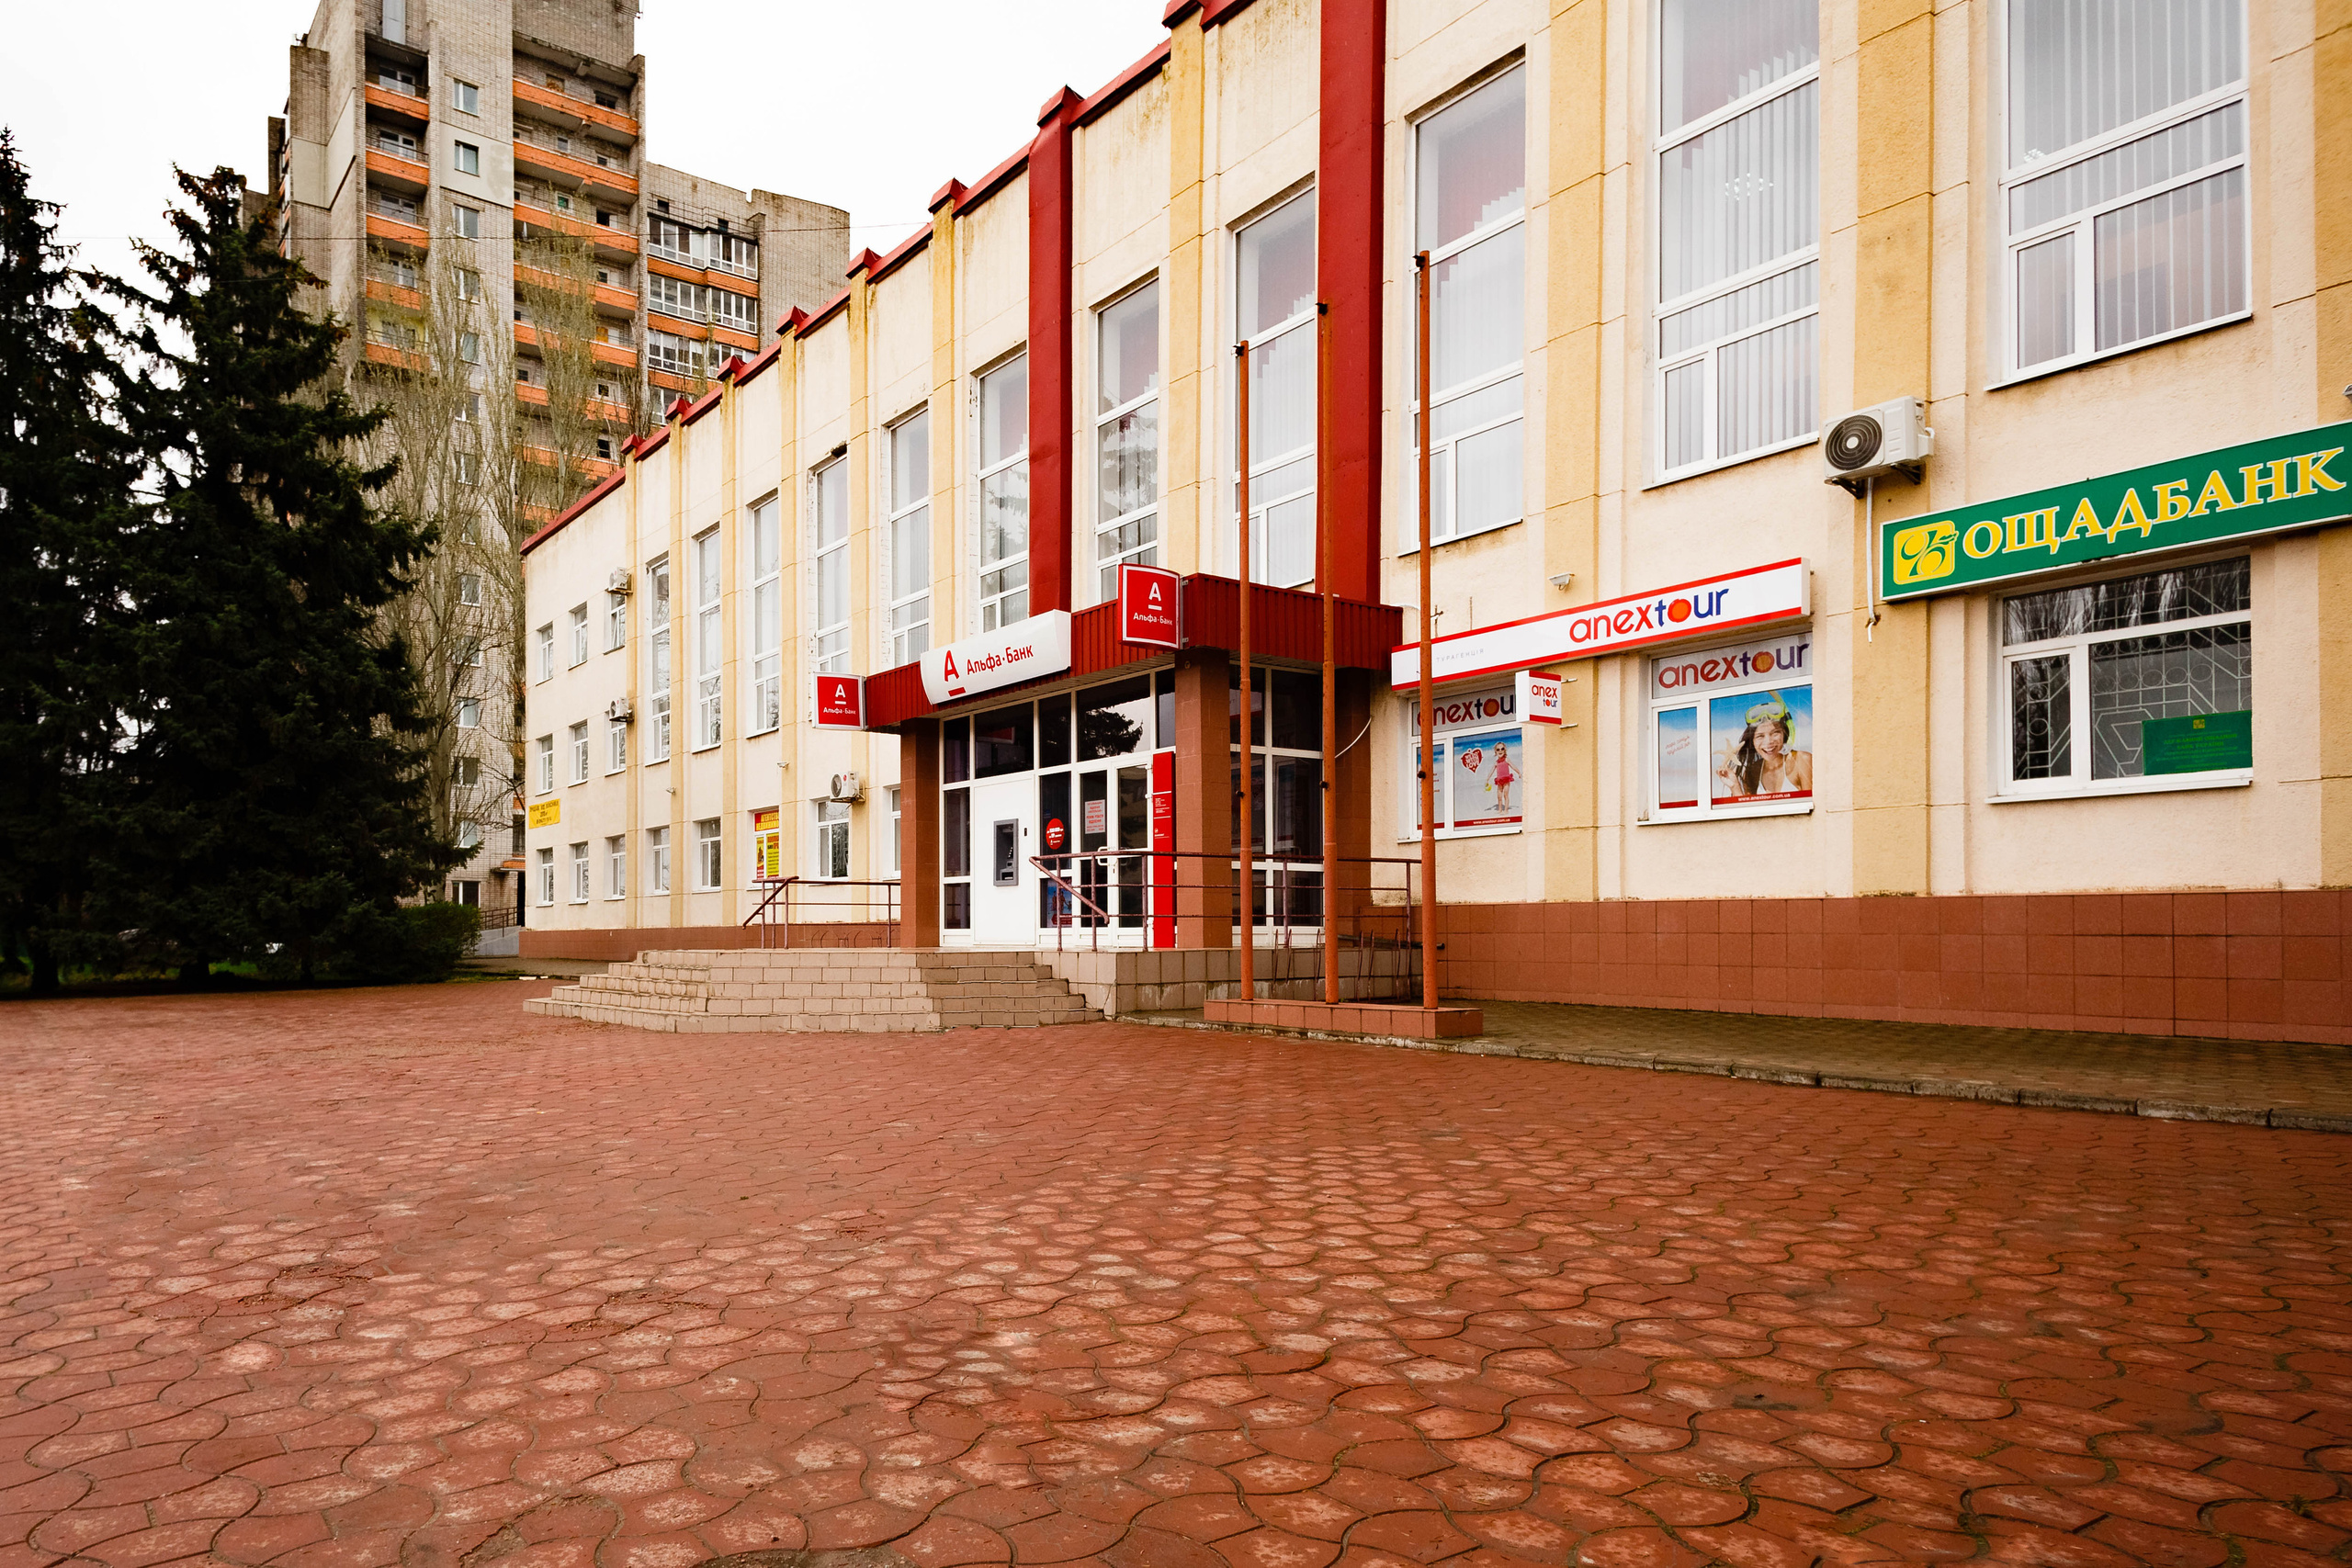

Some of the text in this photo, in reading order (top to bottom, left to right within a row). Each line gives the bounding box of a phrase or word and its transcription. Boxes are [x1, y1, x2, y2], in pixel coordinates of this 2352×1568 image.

[1962, 446, 2346, 559] ОЩАДБАНК
[1569, 588, 1729, 643] anextour
[1658, 643, 1810, 689] anextour
[1417, 694, 1516, 727] nextou
[1532, 684, 1558, 699] anex
[1543, 698, 1558, 708] tour
